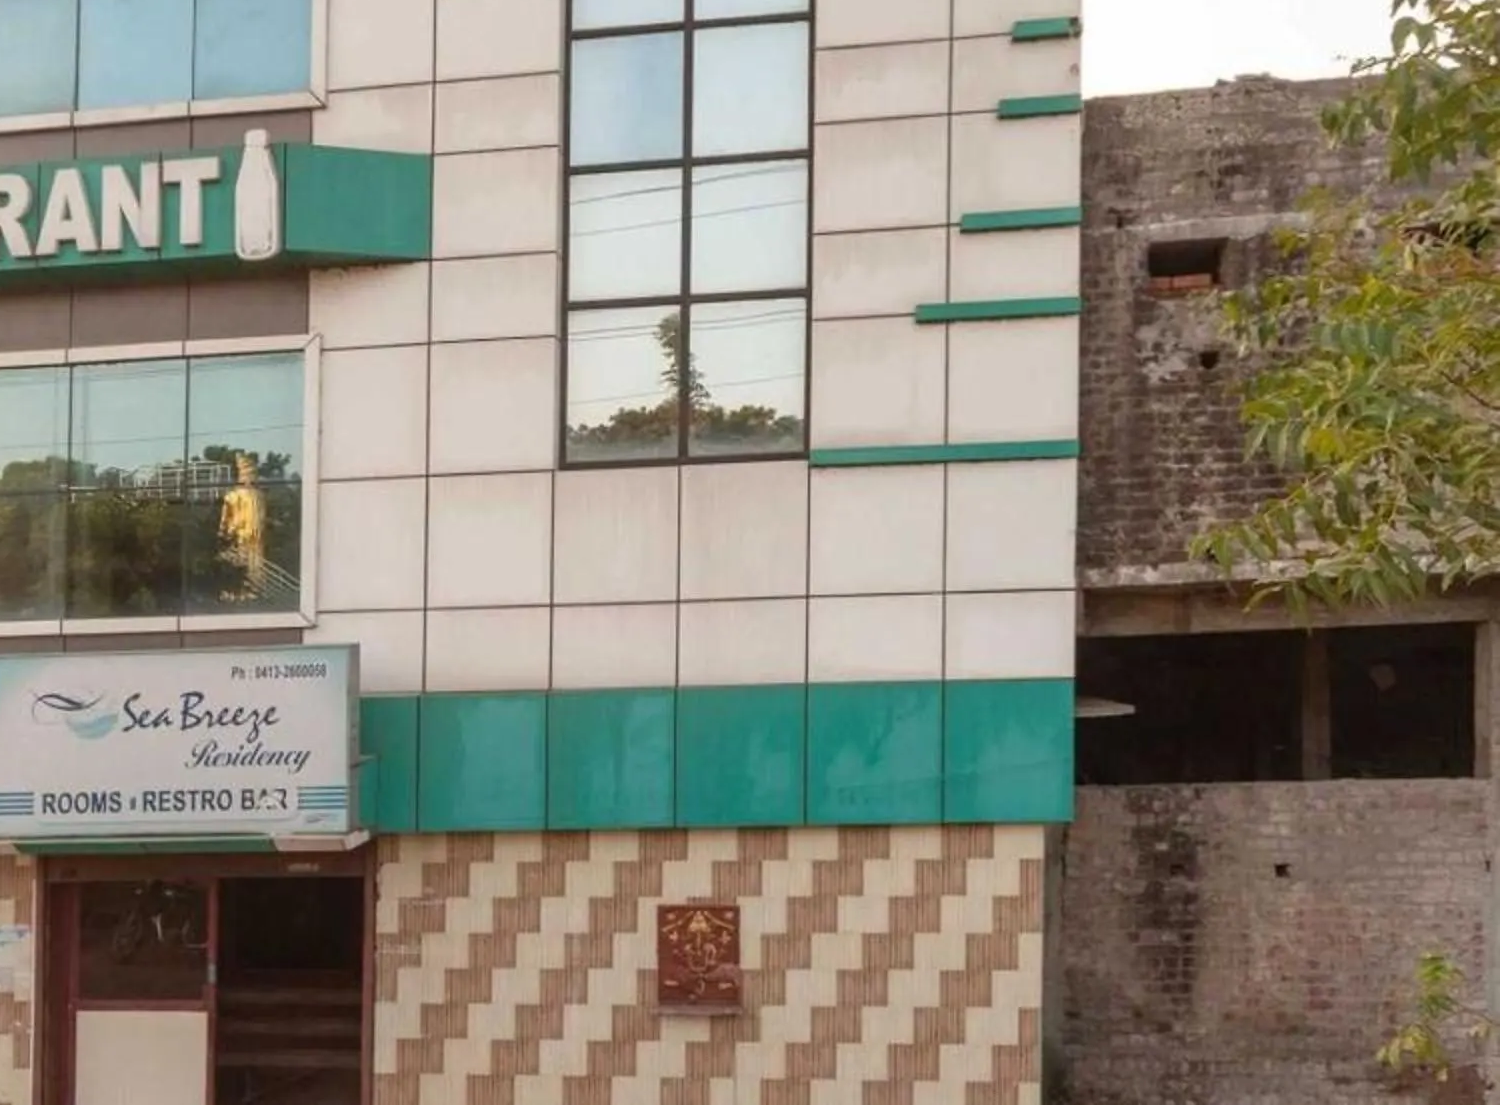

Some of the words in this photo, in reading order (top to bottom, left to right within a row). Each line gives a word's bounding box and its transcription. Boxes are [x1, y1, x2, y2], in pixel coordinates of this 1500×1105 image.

[122, 692, 172, 733] Sea
[180, 691, 279, 743] Breeze
[185, 741, 311, 773] Residency
[42, 791, 122, 815] ROOMS
[142, 790, 233, 813] RESTRO
